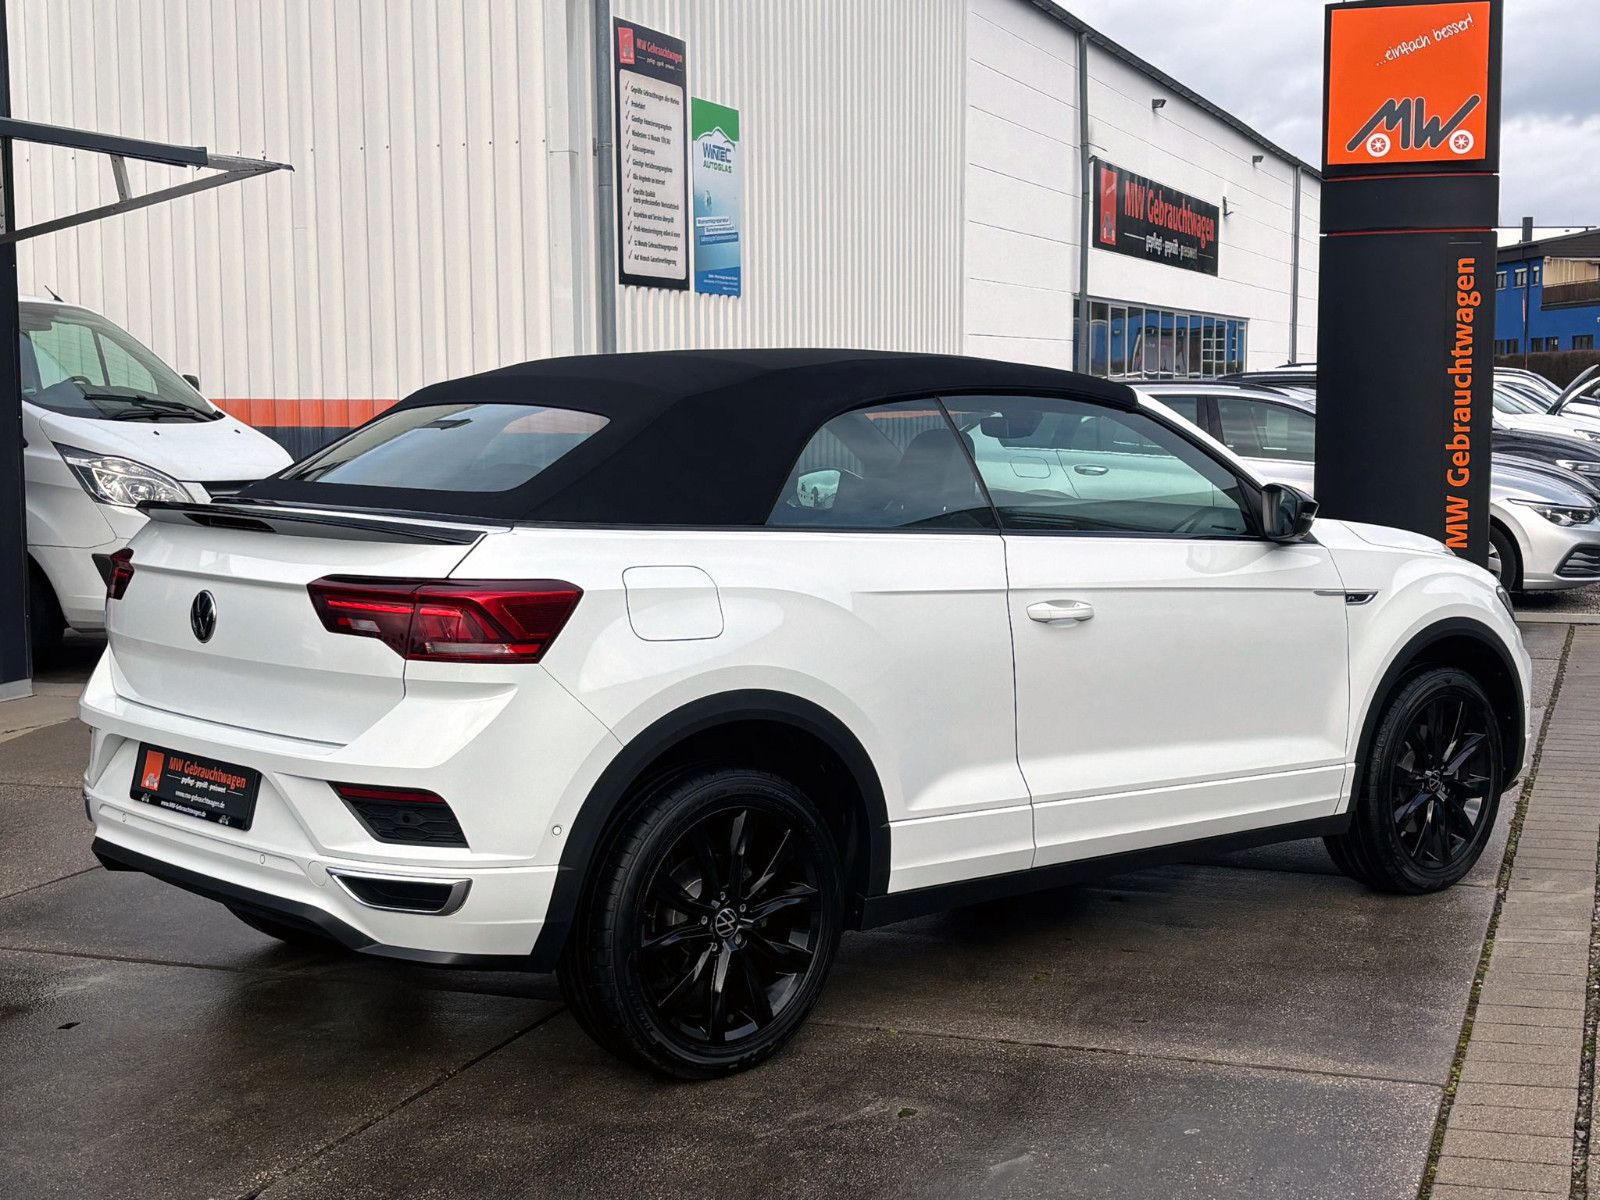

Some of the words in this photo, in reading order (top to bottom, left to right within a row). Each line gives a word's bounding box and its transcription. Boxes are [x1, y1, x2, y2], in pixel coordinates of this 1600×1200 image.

[1433, 13, 1475, 42] besser!
[1346, 94, 1481, 152] MW
[703, 161, 732, 174] AUTOGLAS
[1125, 180, 1145, 220] MW
[1147, 189, 1215, 249] Gebrauchtwagen
[1446, 258, 1482, 487] Gebrauchtwagen
[1446, 495, 1467, 548] MW
[169, 757, 184, 772] MW
[184, 761, 247, 790] Gebrauchtwagen
